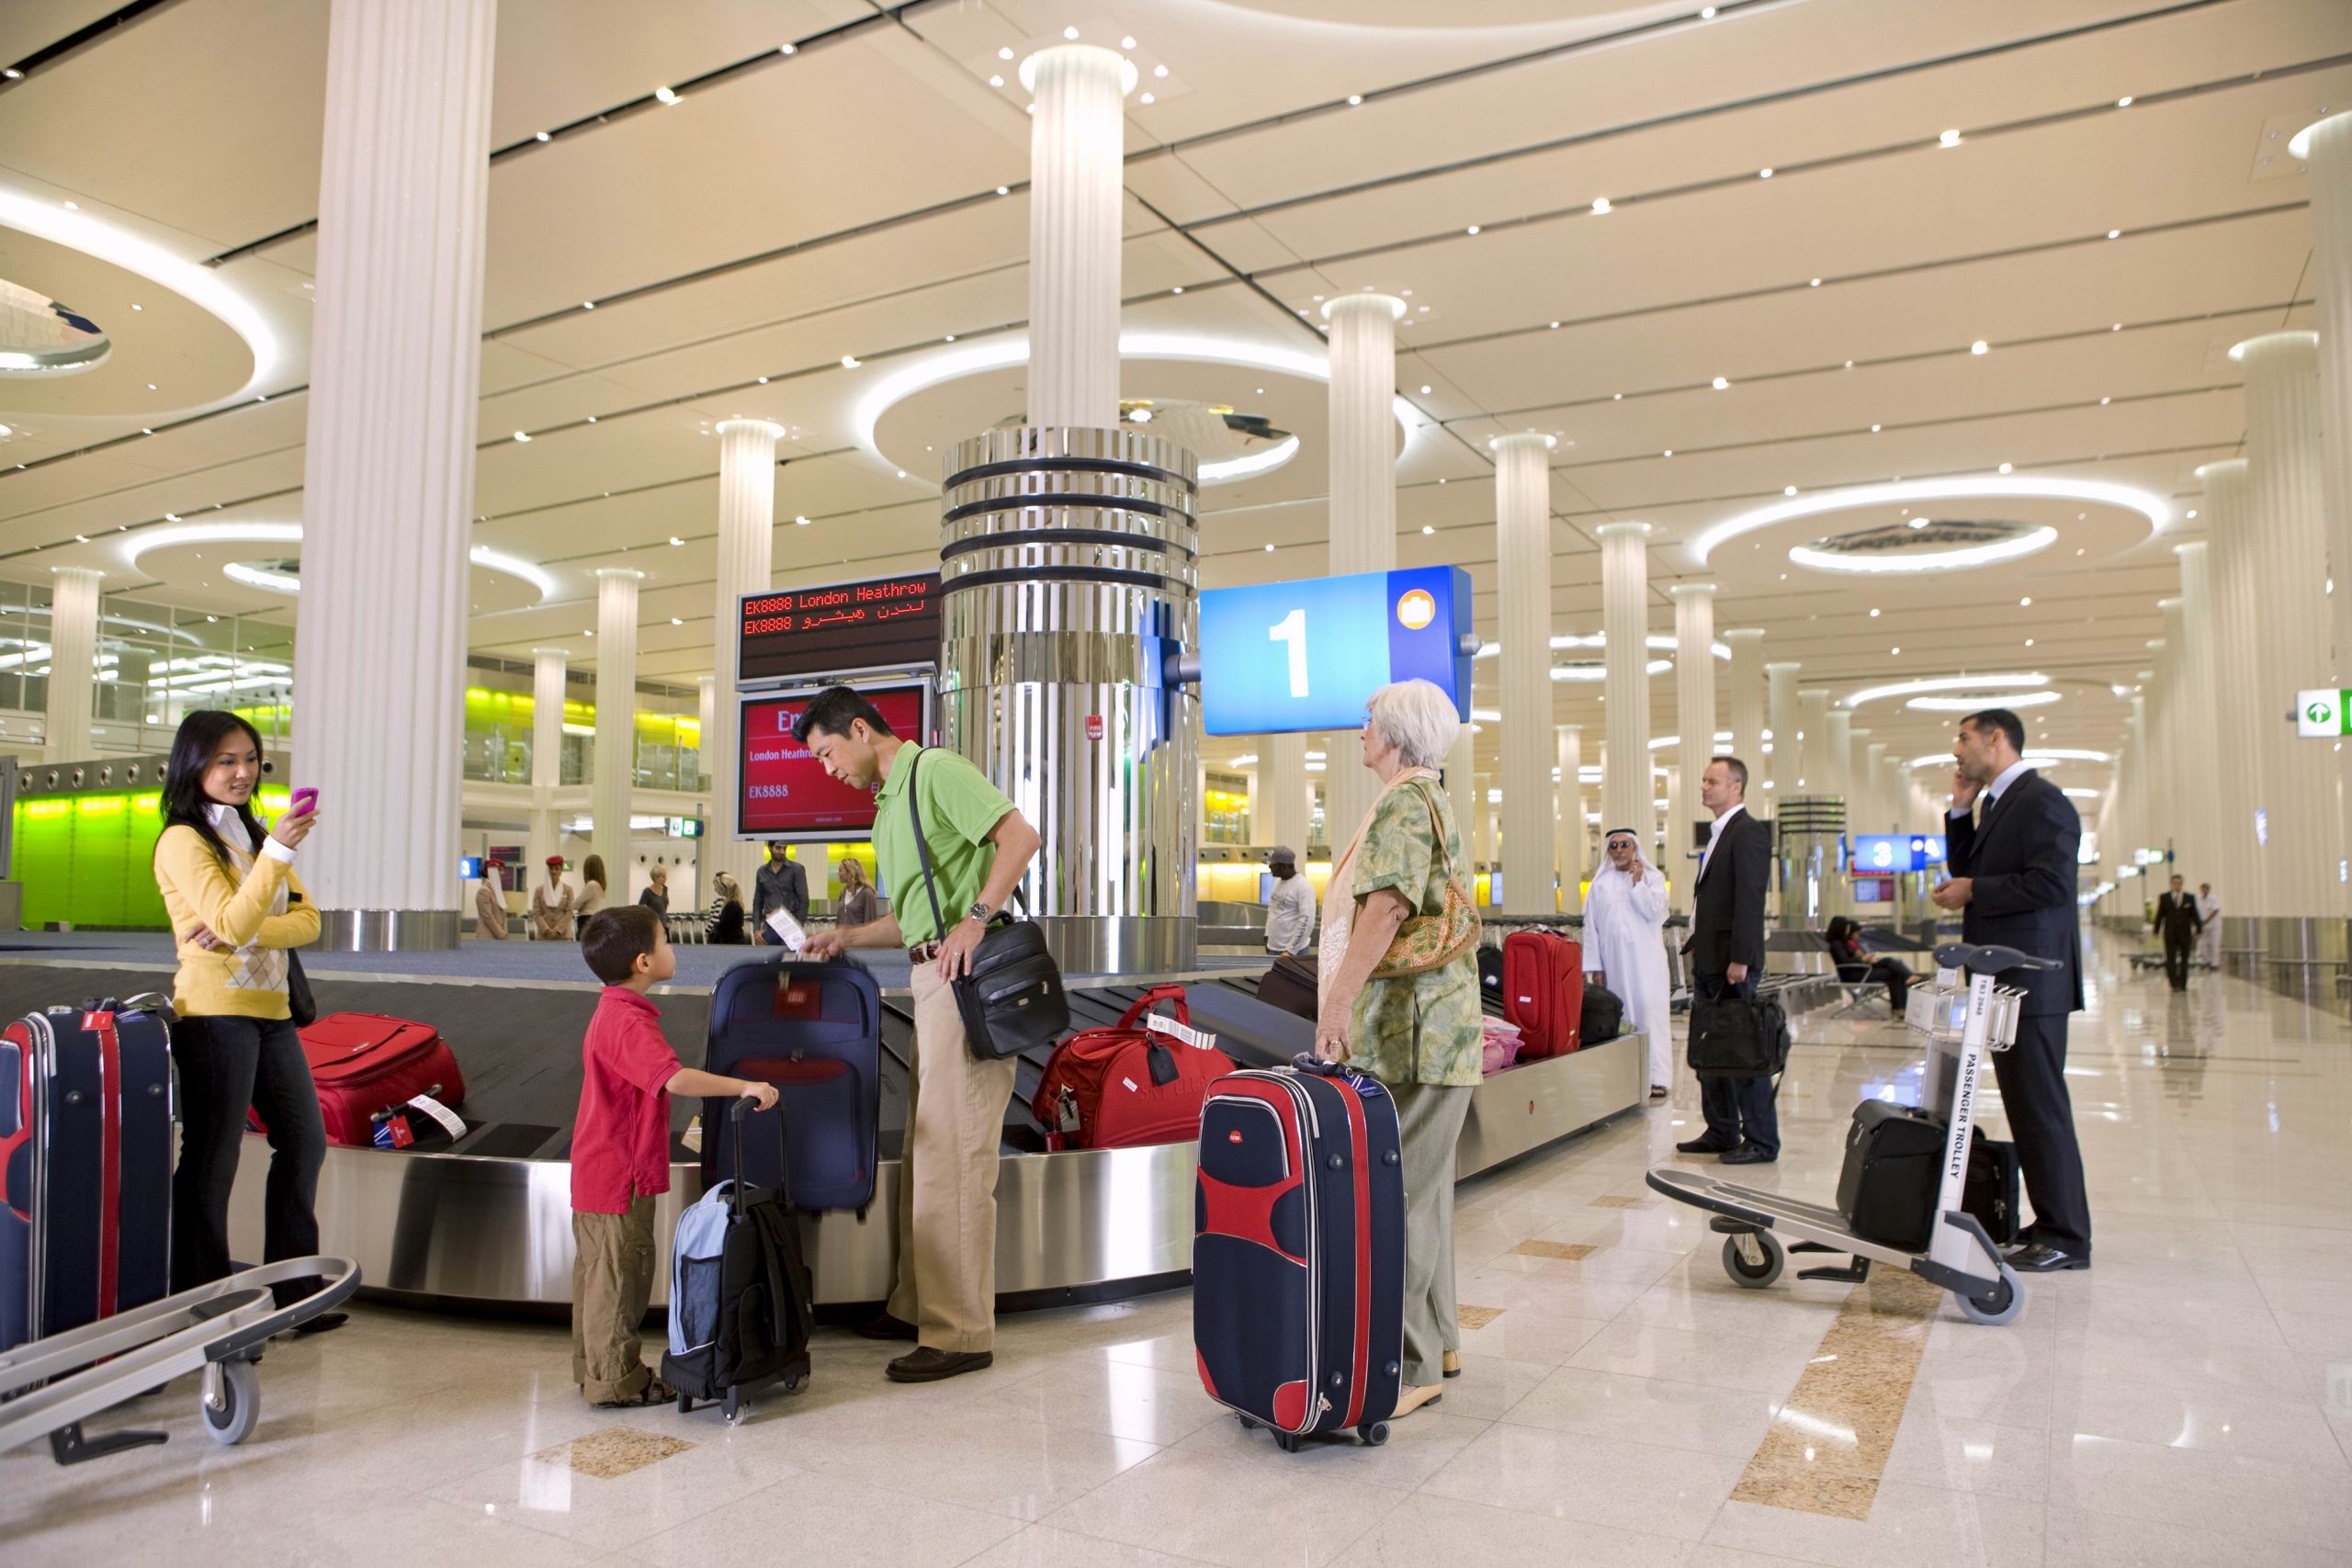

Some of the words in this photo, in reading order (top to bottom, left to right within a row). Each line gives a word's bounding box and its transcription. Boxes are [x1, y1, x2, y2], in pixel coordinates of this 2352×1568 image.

[745, 597, 792, 615] EK8888
[799, 591, 849, 608] London
[856, 582, 926, 602] Heathrow
[877, 600, 924, 618] لندن
[744, 616, 792, 635] EK8888
[1269, 609, 1309, 697] 1
[750, 750, 779, 762] London
[781, 748, 813, 761] Heathro
[749, 785, 788, 799] EK8888
[1873, 841, 1893, 867] 3
[1958, 1053, 1977, 1122] PASSENGER
[1950, 1126, 1966, 1179] TROLLEY
